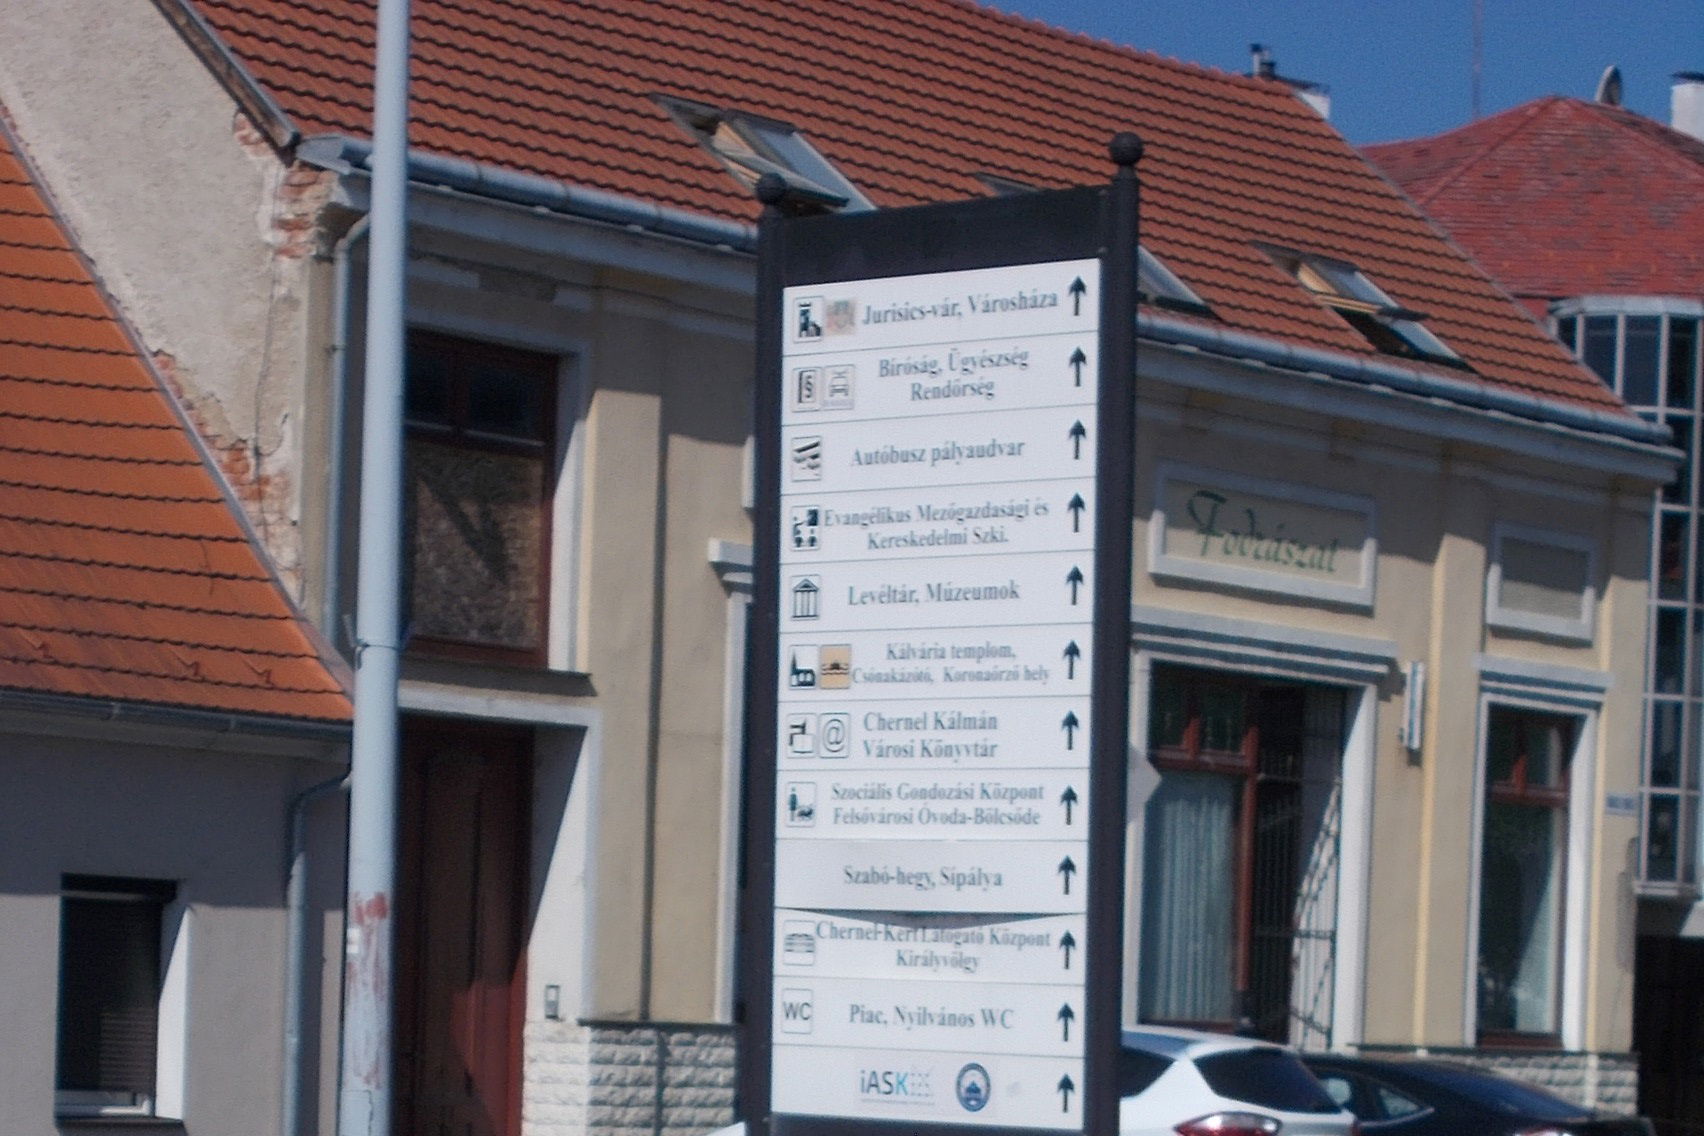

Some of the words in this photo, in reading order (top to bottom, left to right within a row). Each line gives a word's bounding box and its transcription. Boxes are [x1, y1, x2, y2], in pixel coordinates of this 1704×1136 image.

[967, 289, 1058, 314] Városháza
[879, 355, 942, 378] Bíróság,
[948, 347, 1030, 375] Ügyészség
[911, 376, 995, 401] Rendőrség
[851, 444, 925, 466] Autóbusz
[931, 438, 1025, 466] pályaudvar
[824, 506, 911, 529] Evangélikus
[917, 499, 1029, 524] Mezőgazdasági
[1034, 498, 1049, 516] és
[867, 527, 967, 550] Kereskedelmi
[1186, 489, 1338, 572] Fodrászat
[848, 582, 918, 606] Levéltár,
[925, 580, 1020, 604] Múzeumok
[886, 642, 946, 660] Kálvária
[1024, 665, 1049, 685] hely
[863, 711, 927, 732] Chernel
[932, 710, 998, 731] Kálmán
[863, 738, 914, 759] Városi
[920, 738, 999, 763] Könyvtár
[831, 782, 892, 801] Szociális
[897, 782, 974, 801] Gondozási
[979, 782, 1044, 804] Központ
[940, 865, 1003, 889] Sípálya
[988, 926, 1051, 951] Központ
[896, 948, 978, 973] Királyvölgy
[783, 1002, 812, 1021] WC
[849, 1003, 887, 1025] Piac,
[895, 1004, 975, 1030] Nyilvános
[981, 1008, 1015, 1029] WC
[859, 1069, 909, 1096] iASK
